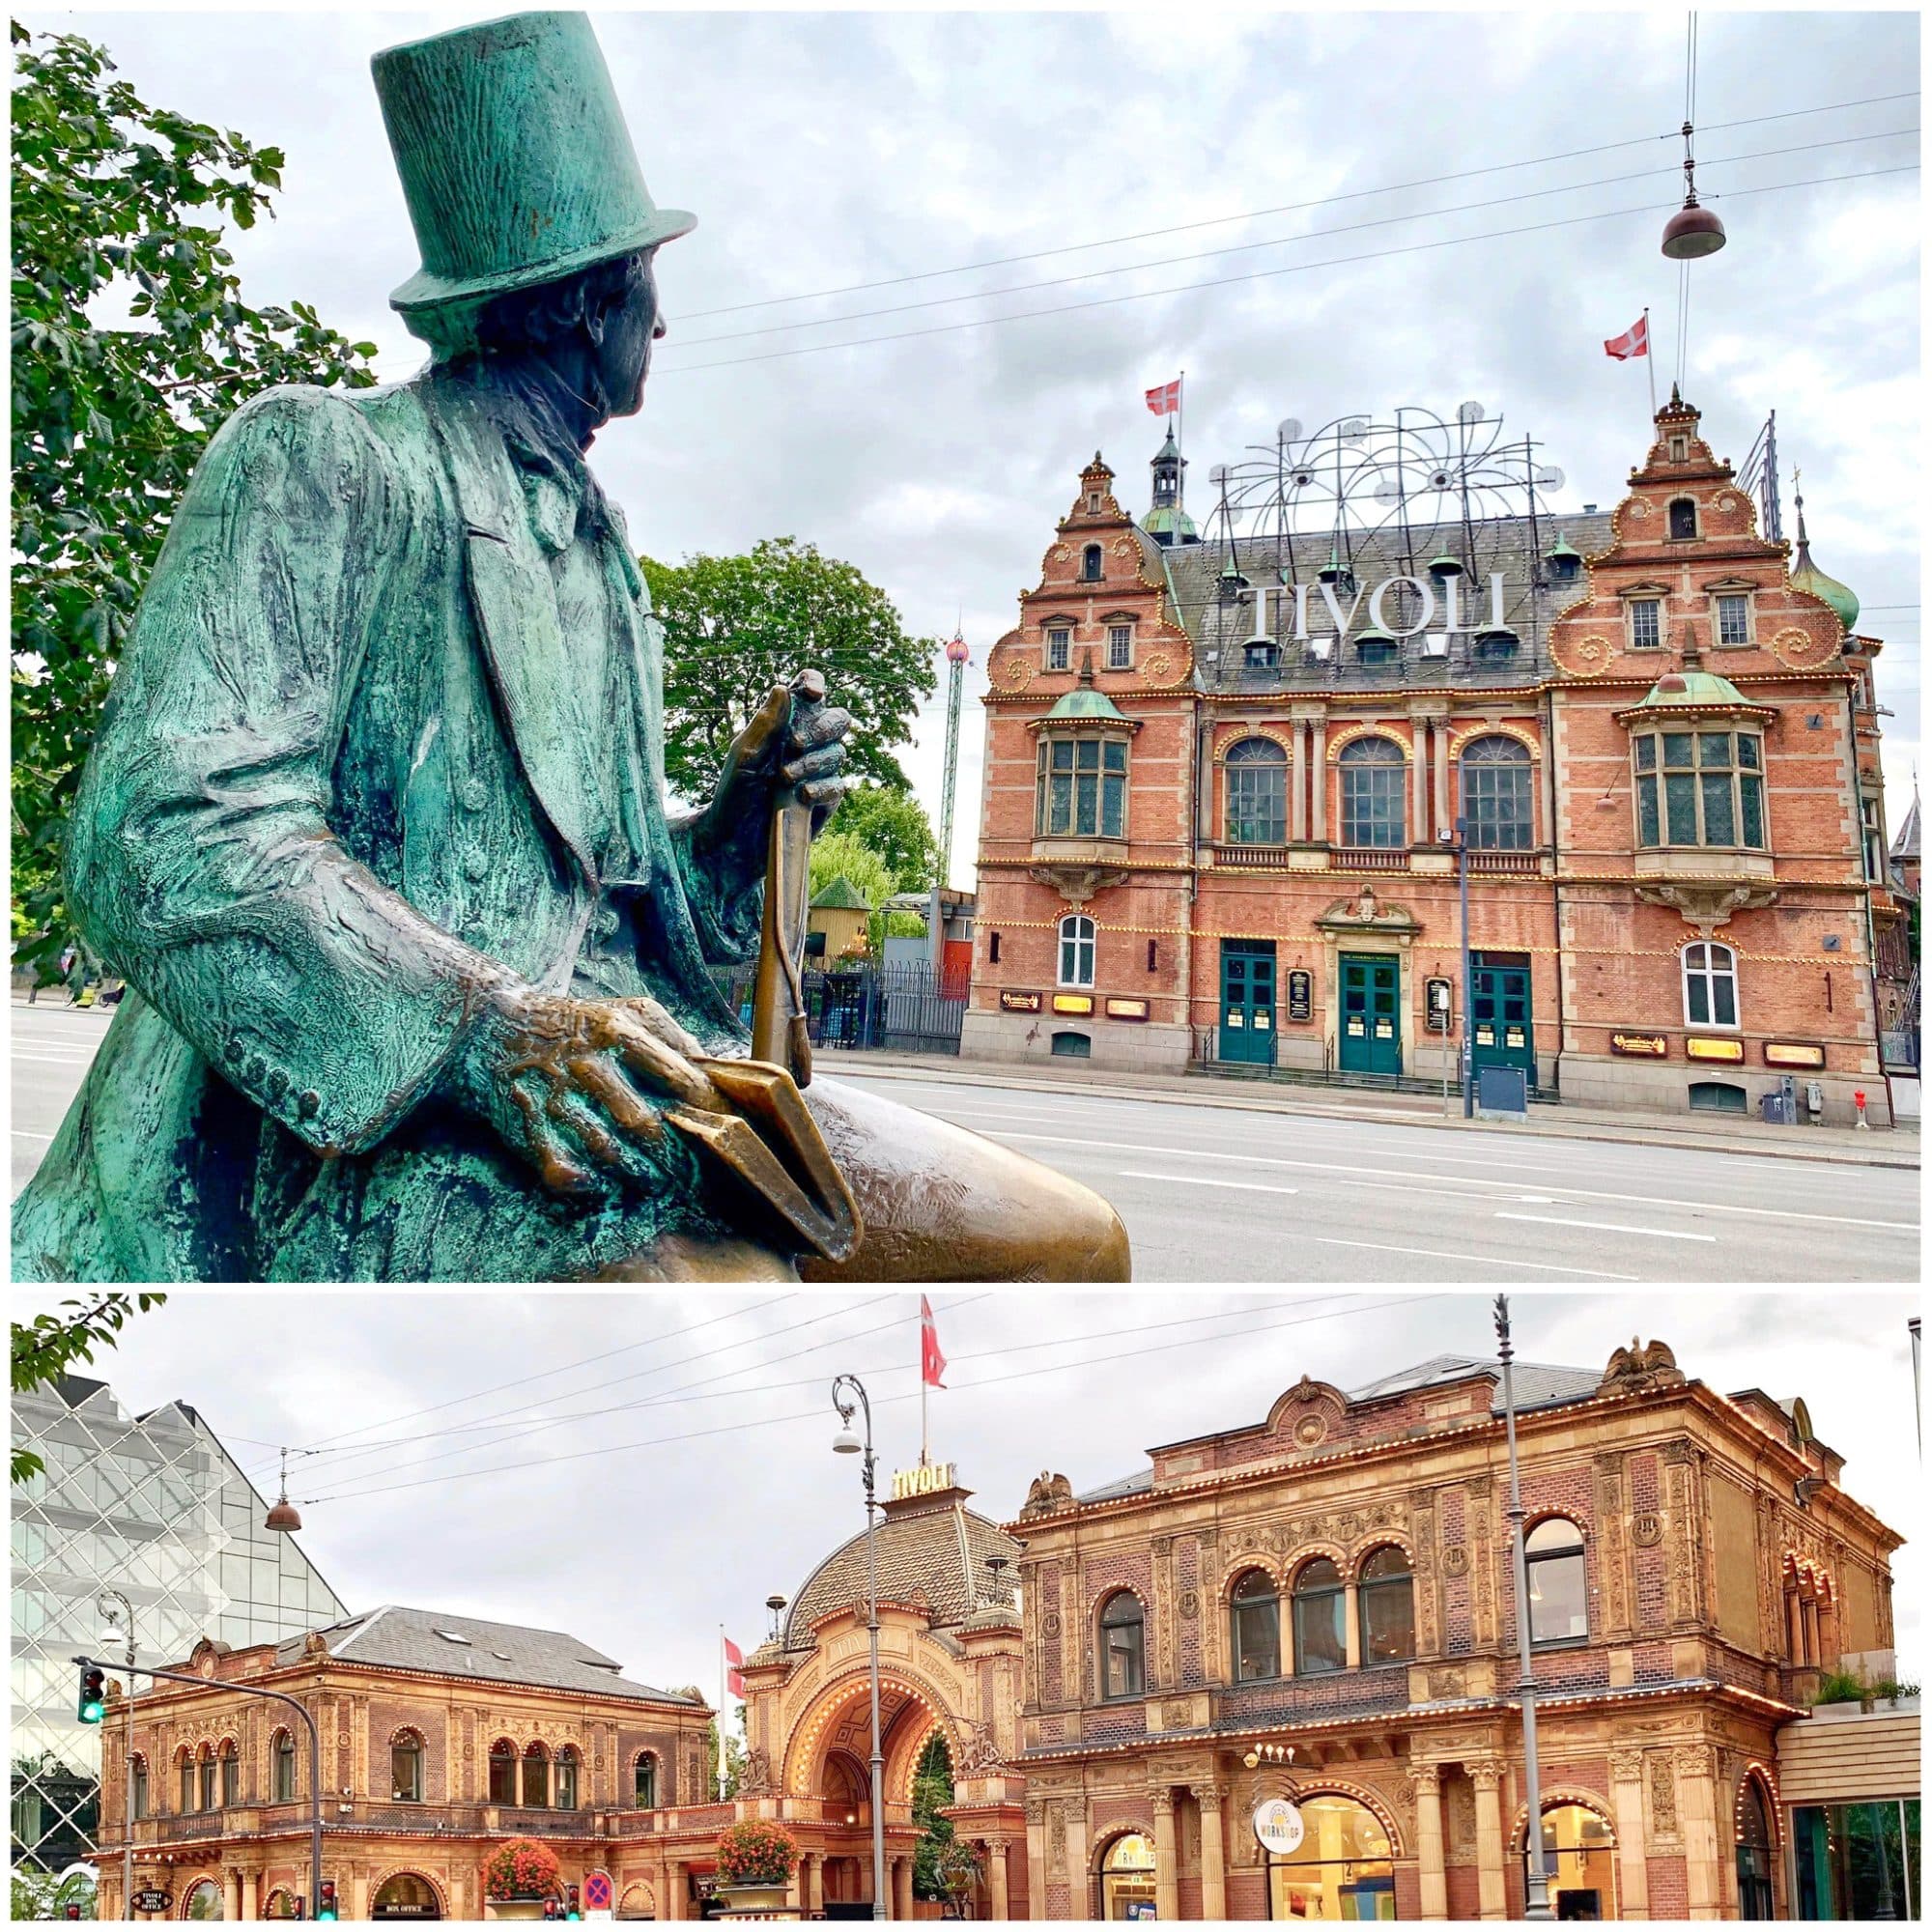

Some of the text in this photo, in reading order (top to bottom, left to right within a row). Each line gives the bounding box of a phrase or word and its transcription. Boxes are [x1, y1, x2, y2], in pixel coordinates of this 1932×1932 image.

[1236, 573, 1509, 641] TIVOLI
[892, 1463, 950, 1500] TIVOLI
[1260, 1824, 1299, 1839] WORKSHOP
